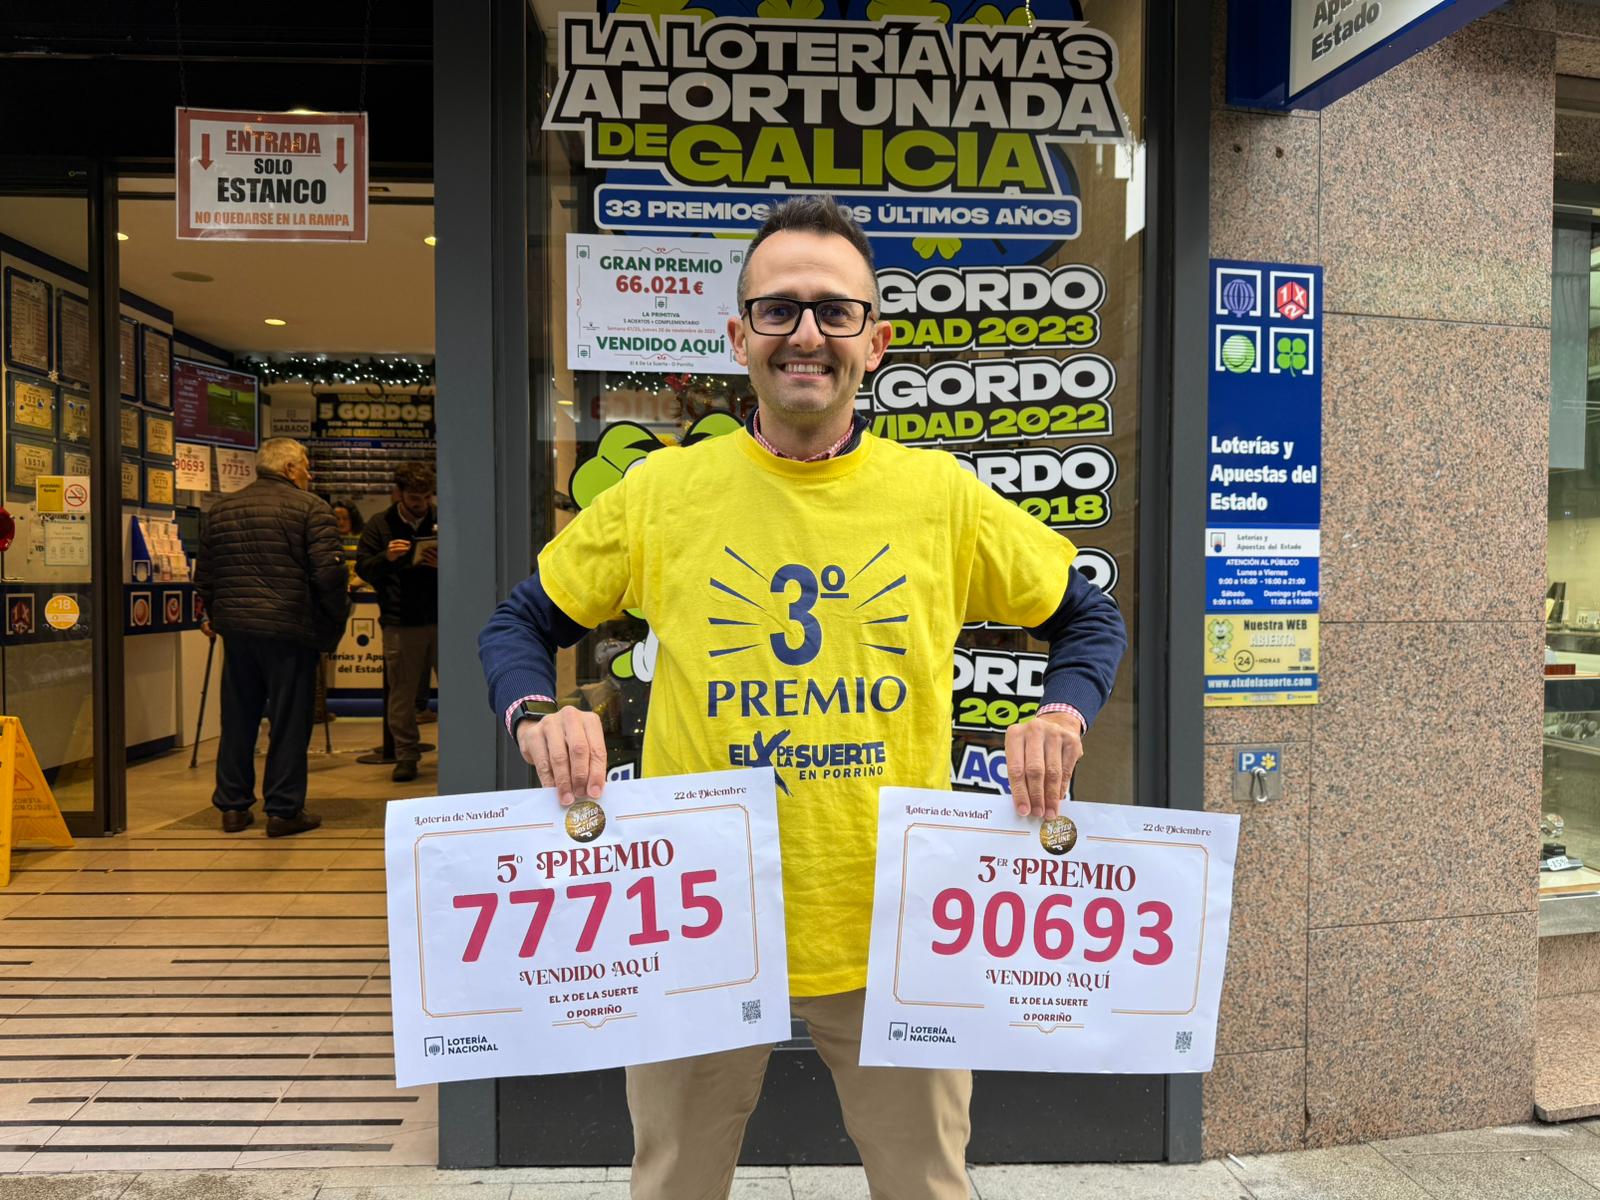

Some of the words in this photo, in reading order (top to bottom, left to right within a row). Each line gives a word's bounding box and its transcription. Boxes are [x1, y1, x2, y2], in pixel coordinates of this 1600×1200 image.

[1312, 2, 1380, 61] Estado
[571, 25, 655, 67] LA
[672, 27, 949, 76] LOTERÍA
[965, 32, 1107, 80] MÁS
[560, 69, 1117, 131] AFORTUNADA
[225, 130, 321, 154] ENTRADA
[598, 122, 667, 157] DE
[669, 124, 1047, 188] GALICIA
[254, 158, 293, 175] SOLO
[217, 177, 326, 205] ESTANCO
[195, 211, 210, 224] NO
[214, 211, 273, 225] QUEDARSE
[276, 212, 289, 225] EN
[292, 213, 306, 225] LA
[309, 213, 349, 226] RAMPA
[605, 199, 641, 217] 33
[648, 200, 770, 221] PREMIOS
[878, 203, 990, 225] ÚLTIMOS
[995, 205, 1071, 226] AÑOS
[600, 256, 650, 271] GRAN
[655, 258, 723, 274] PREMIO
[878, 271, 1099, 314] GORDO
[888, 317, 973, 346] DAD
[978, 314, 1094, 344] 2023
[596, 336, 677, 352] VENDIDO
[680, 335, 725, 355] AQUÍ
[878, 360, 1110, 408] GORDO
[319, 402, 335, 420] 5
[337, 402, 433, 422] GORDOS
[989, 403, 1106, 435] 2022
[1211, 435, 1279, 455] Loterías
[1283, 441, 1294, 460] y
[174, 458, 205, 473] 90693
[221, 463, 250, 477] 77715
[1210, 464, 1288, 487] Apuestas
[1291, 465, 1317, 484] del
[1014, 494, 1104, 523] 018
[1210, 492, 1268, 511] Estado
[1237, 543, 1266, 551] Apuestas
[1225, 558, 1260, 566] ATENCIÓN
[1260, 558, 1270, 566] AL
[1270, 558, 1300, 567] PÚBLICO
[1264, 569, 1288, 577] Viernes
[1263, 590, 1291, 598] Domingo
[769, 563, 849, 666] 3º
[1244, 620, 1284, 631] Nuestra
[1286, 620, 1308, 630] WEB
[338, 665, 352, 673] del
[1237, 656, 1251, 666] 24
[707, 675, 907, 717] PREMIO
[729, 744, 755, 767] EL
[777, 746, 794, 757] DE
[795, 741, 886, 768] SUERTE
[777, 757, 793, 768] LA
[1241, 753, 1256, 771] P
[799, 770, 817, 780] EN
[824, 764, 884, 779] PORRIÑO
[452, 812, 464, 822] de
[466, 806, 509, 821] Navidad
[674, 791, 685, 800] 22
[686, 790, 697, 799] de
[698, 786, 747, 799] Diciembre
[940, 807, 952, 817] de
[952, 808, 993, 820] Navidad
[1143, 823, 1153, 832] 22
[1154, 824, 1165, 833] de
[1166, 825, 1212, 836] Diciembre
[536, 839, 675, 879] PREMIO
[1013, 858, 1137, 891] PREMIO
[452, 869, 723, 962] 77715
[931, 887, 1174, 965] 90693
[519, 963, 606, 986] VENDIDO
[611, 952, 660, 978] AQUÍ
[986, 969, 1062, 987] VENDIDO
[1066, 969, 1110, 992] AQUÍ
[549, 995, 561, 1004] EL
[562, 994, 570, 1002] X
[574, 992, 585, 1001] DE
[587, 990, 600, 1000] LA
[601, 986, 639, 998] SUERTE
[1009, 996, 1020, 1005] EL
[1021, 996, 1028, 1005] X
[1030, 997, 1041, 1005] DE
[1042, 997, 1054, 1006] LA
[1055, 998, 1089, 1007] SUERTE
[567, 1010, 575, 1019] O
[577, 1004, 622, 1018] PORRIÑO
[1023, 1013, 1030, 1021] O
[1032, 1012, 1072, 1023] PORRIÑO
[447, 1034, 488, 1046] LOTERÍA
[909, 1034, 957, 1044] NACIONAL
[910, 1025, 948, 1035] LOTERÍA
[448, 1043, 499, 1055] NACIONAL
